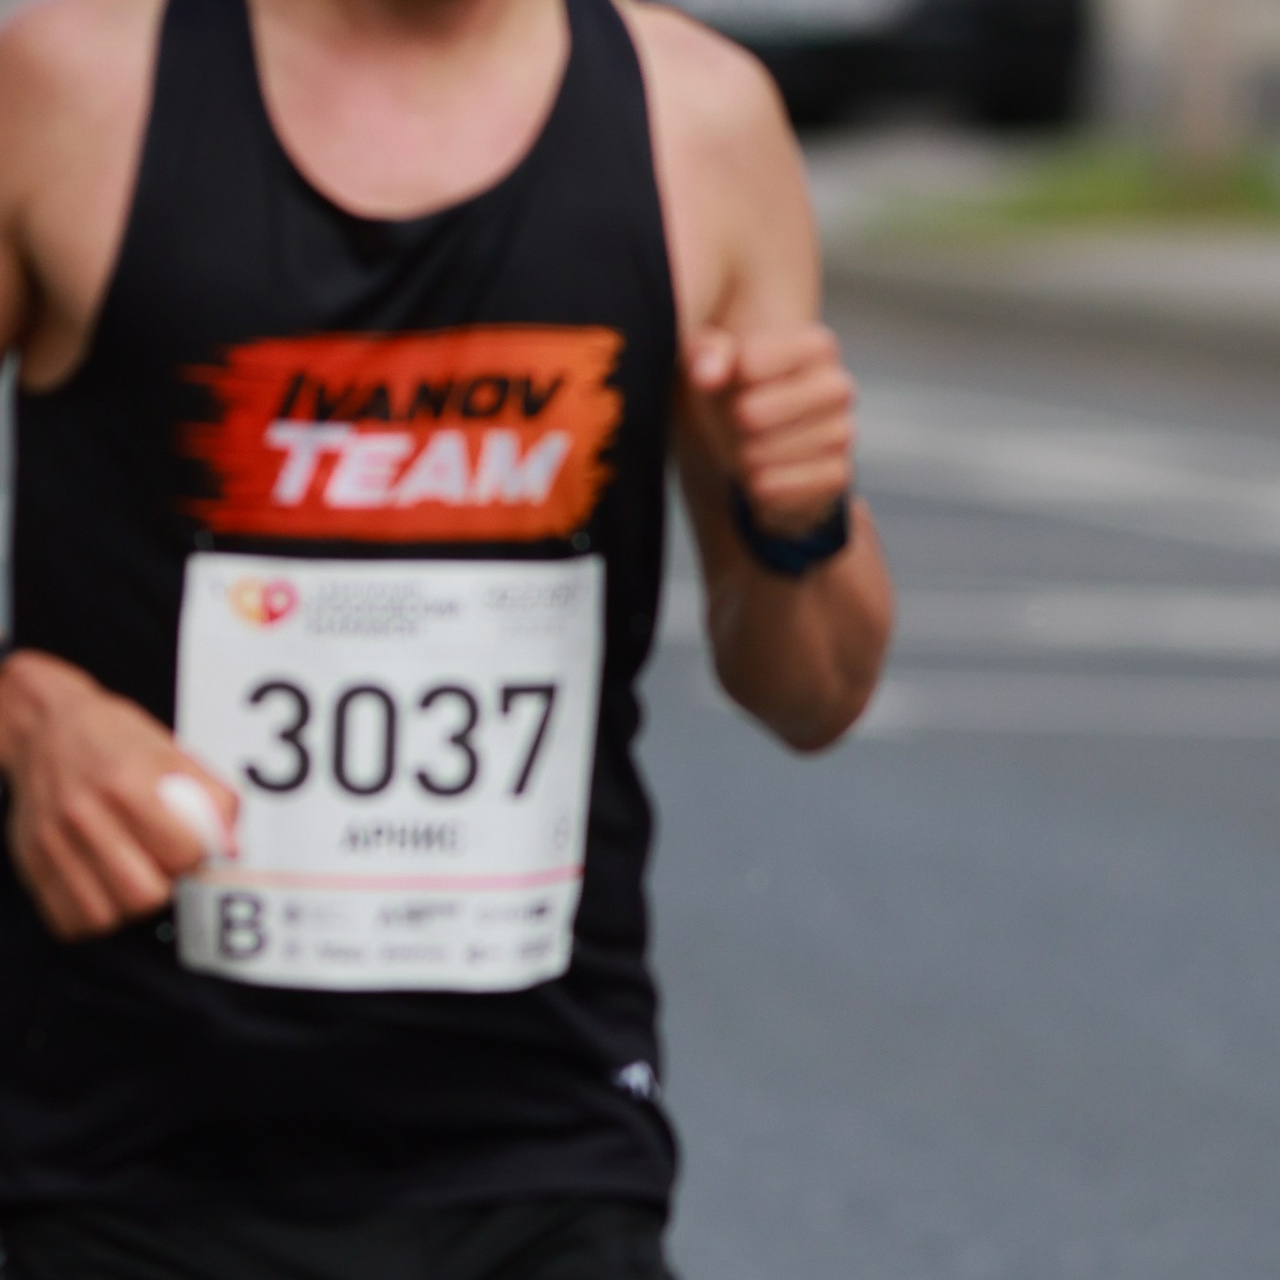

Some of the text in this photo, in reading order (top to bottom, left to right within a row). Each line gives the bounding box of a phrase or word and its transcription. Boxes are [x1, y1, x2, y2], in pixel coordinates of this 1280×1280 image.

[276, 370, 566, 424] IVANOV
[265, 421, 573, 509] TEAM
[242, 679, 561, 799] 3037
[219, 890, 265, 959] B
